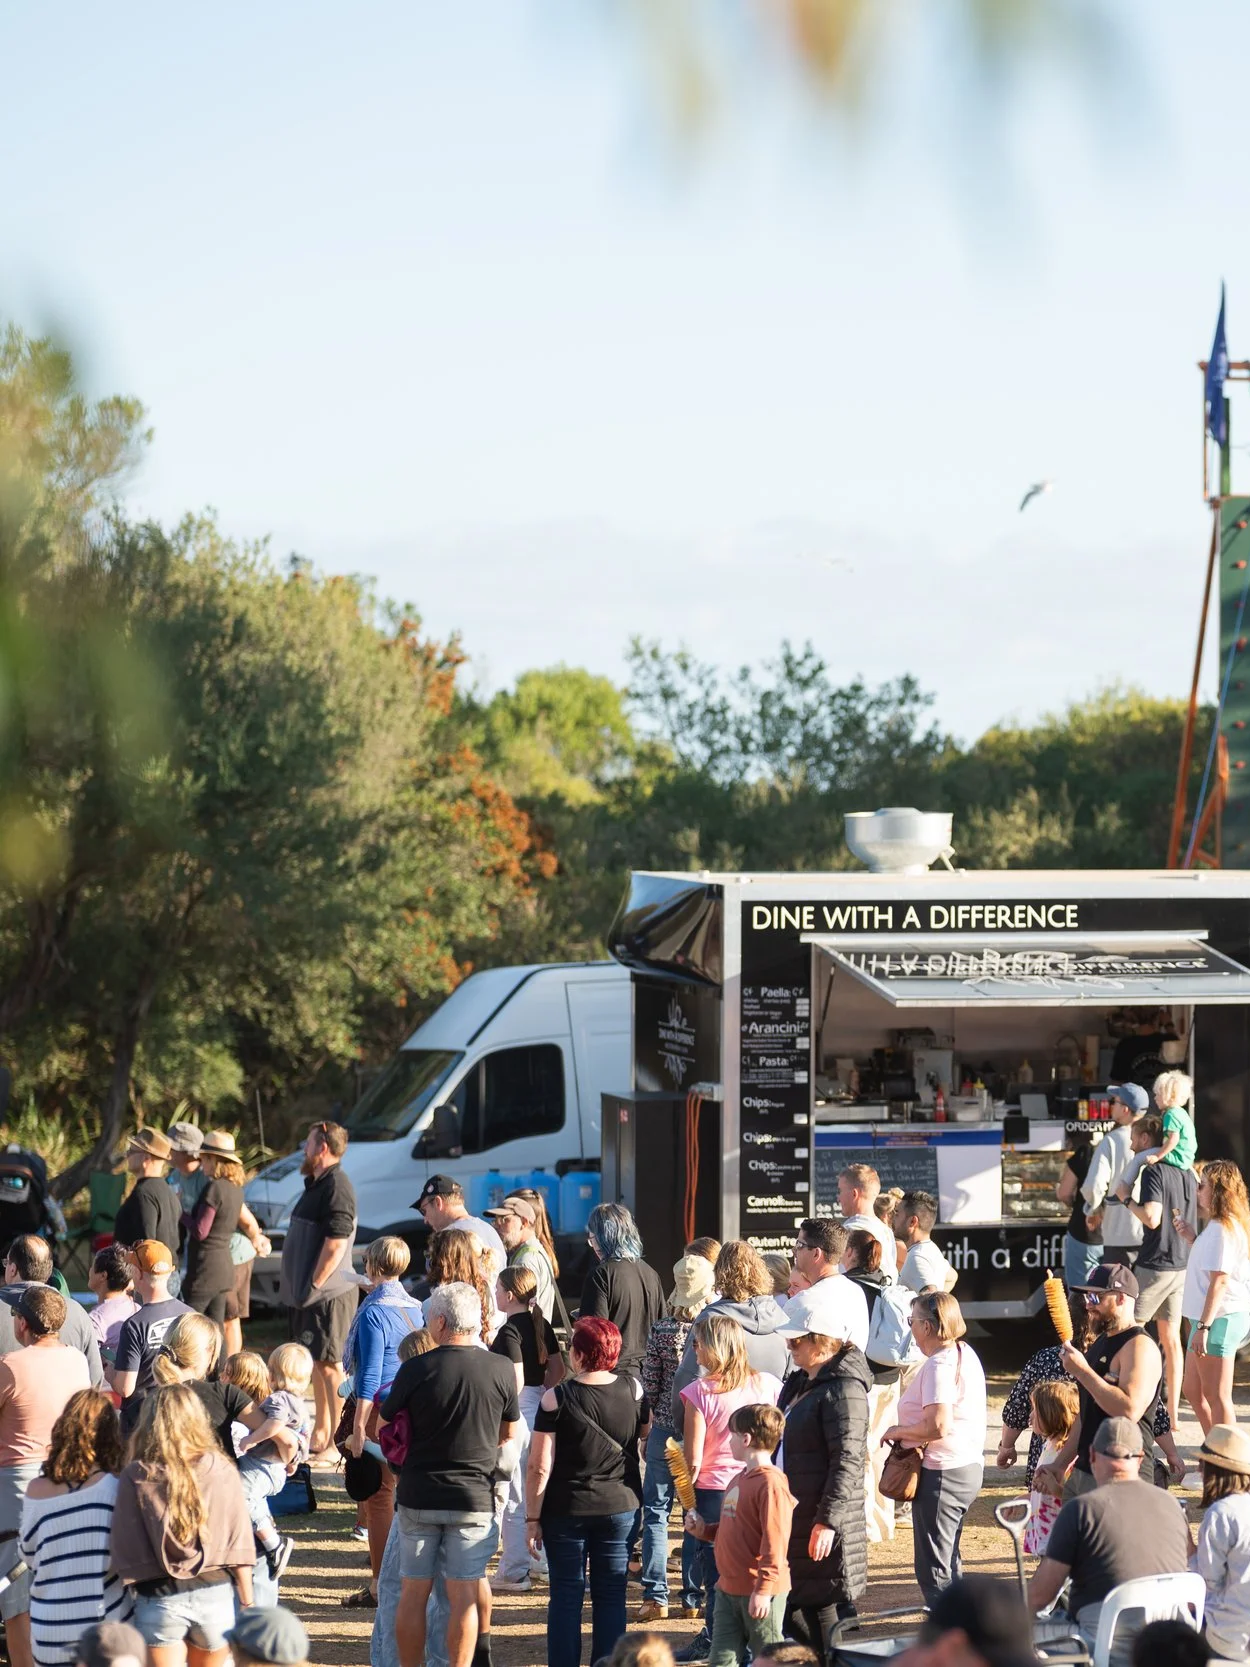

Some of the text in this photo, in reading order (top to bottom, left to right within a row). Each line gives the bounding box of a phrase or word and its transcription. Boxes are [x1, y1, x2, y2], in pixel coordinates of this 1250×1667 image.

[752, 904, 1079, 930] DINE WITH A DIFFERENCE
[1065, 1121, 1102, 1132] ORDER
[747, 1235, 798, 1249] Gluten Fre
[944, 1236, 979, 1270] ith
[991, 1248, 1011, 1269] a
